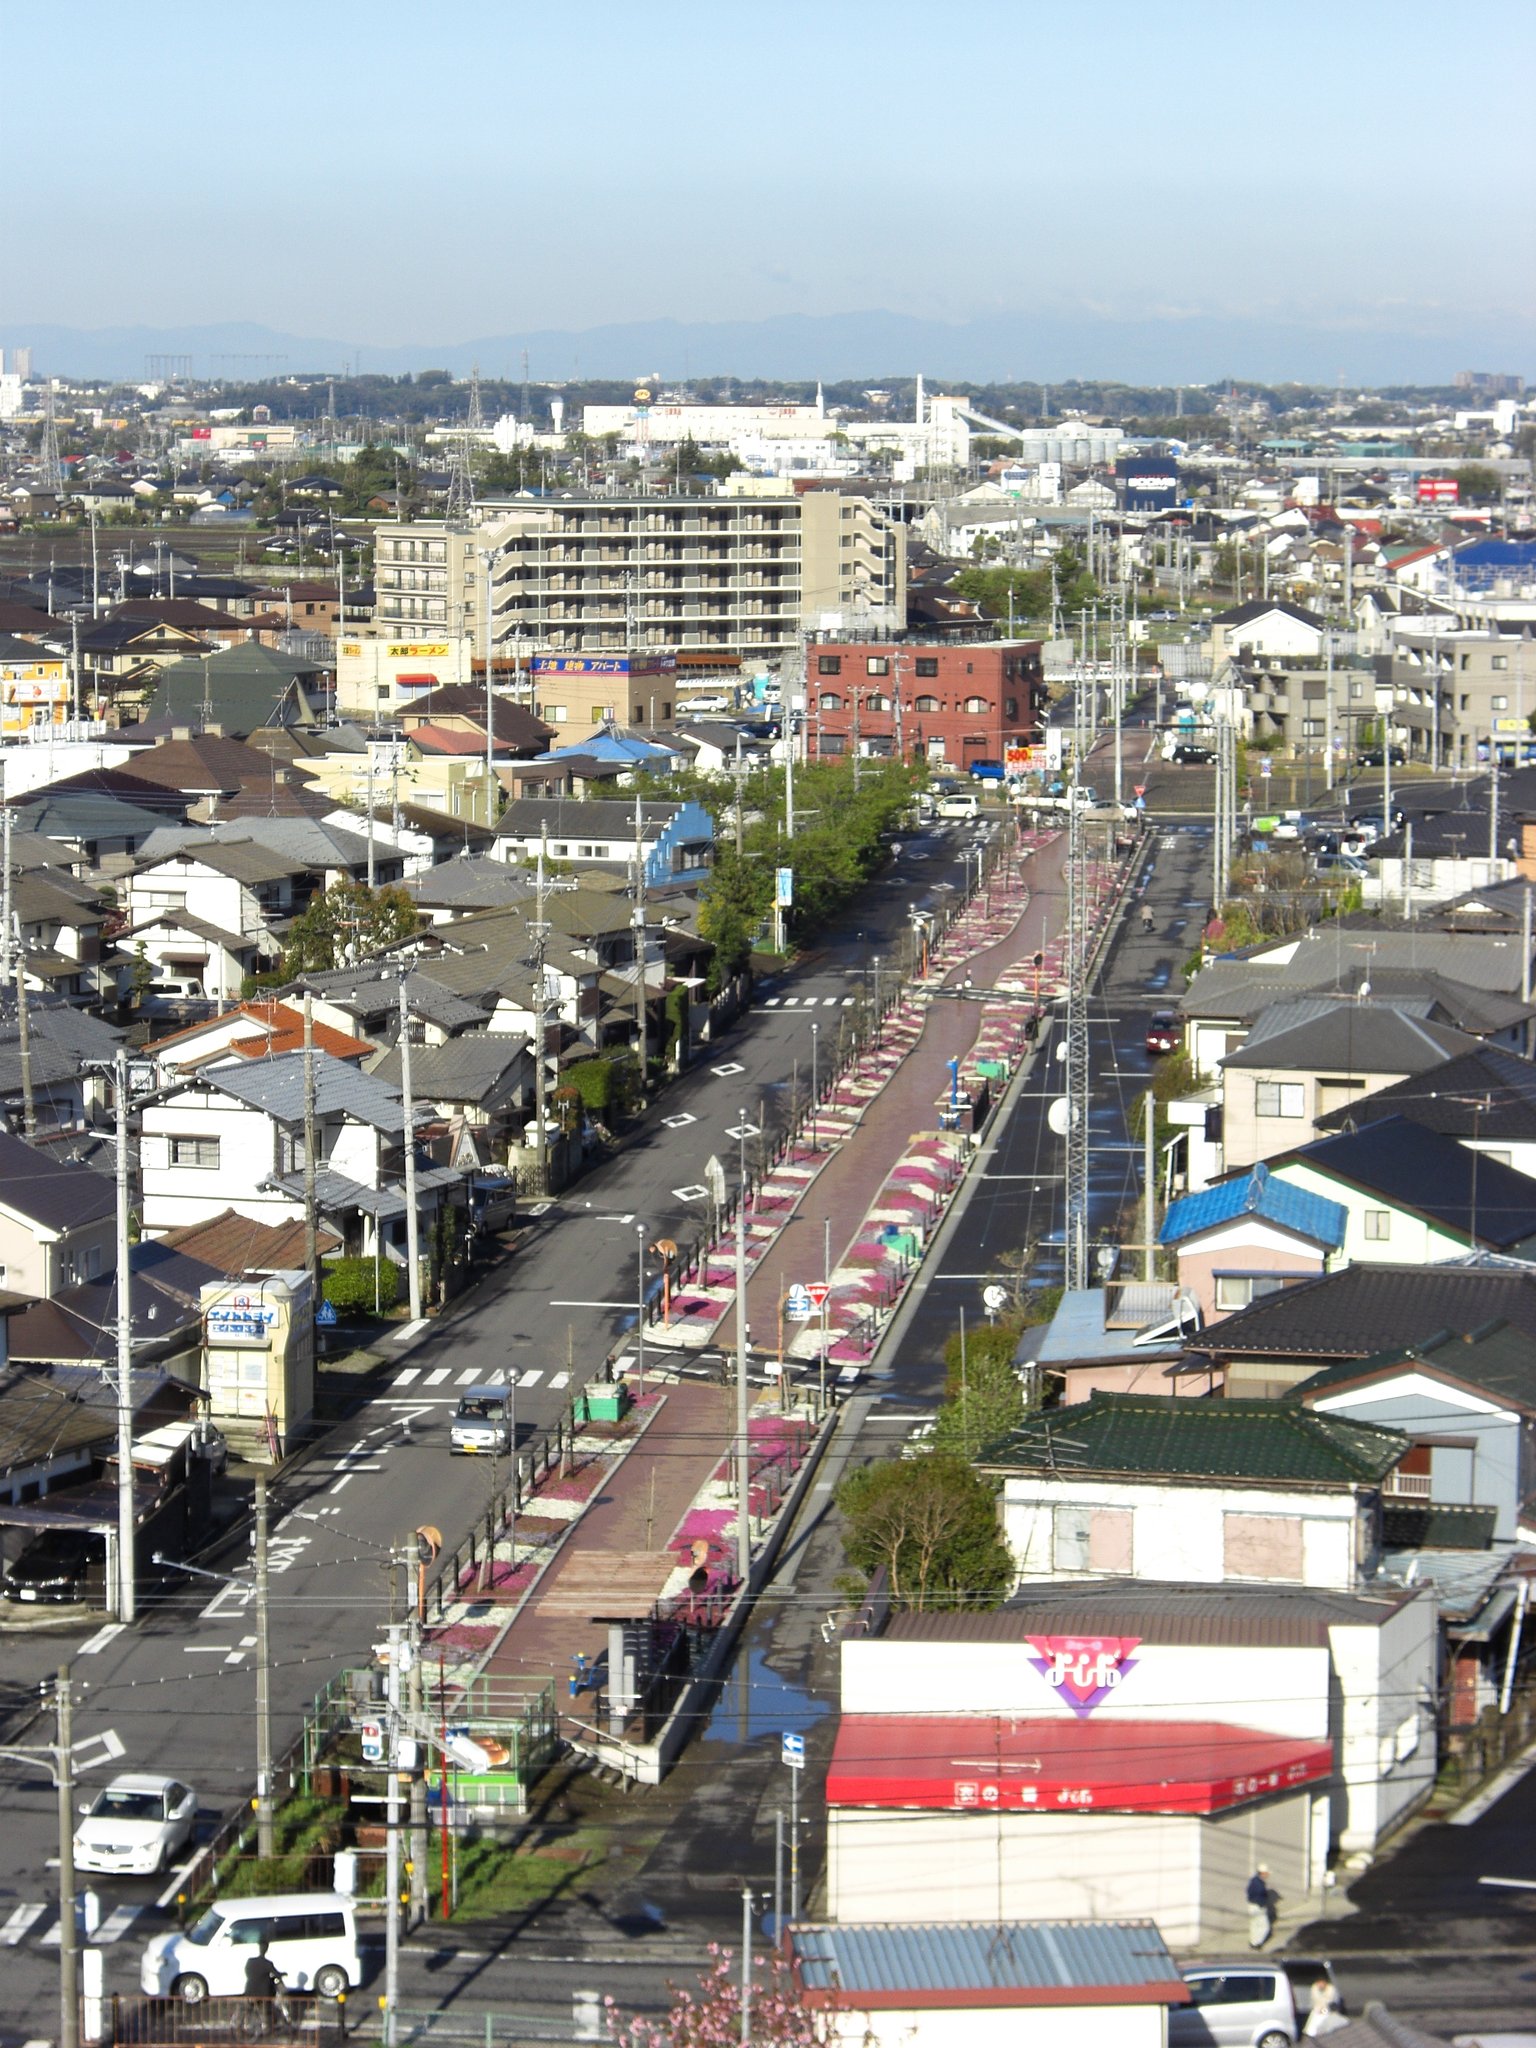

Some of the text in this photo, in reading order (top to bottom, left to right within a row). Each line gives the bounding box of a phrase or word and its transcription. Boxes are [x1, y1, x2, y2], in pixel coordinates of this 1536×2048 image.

[390, 647, 446, 656] 太郎ラーメン
[590, 661, 621, 672] アパート
